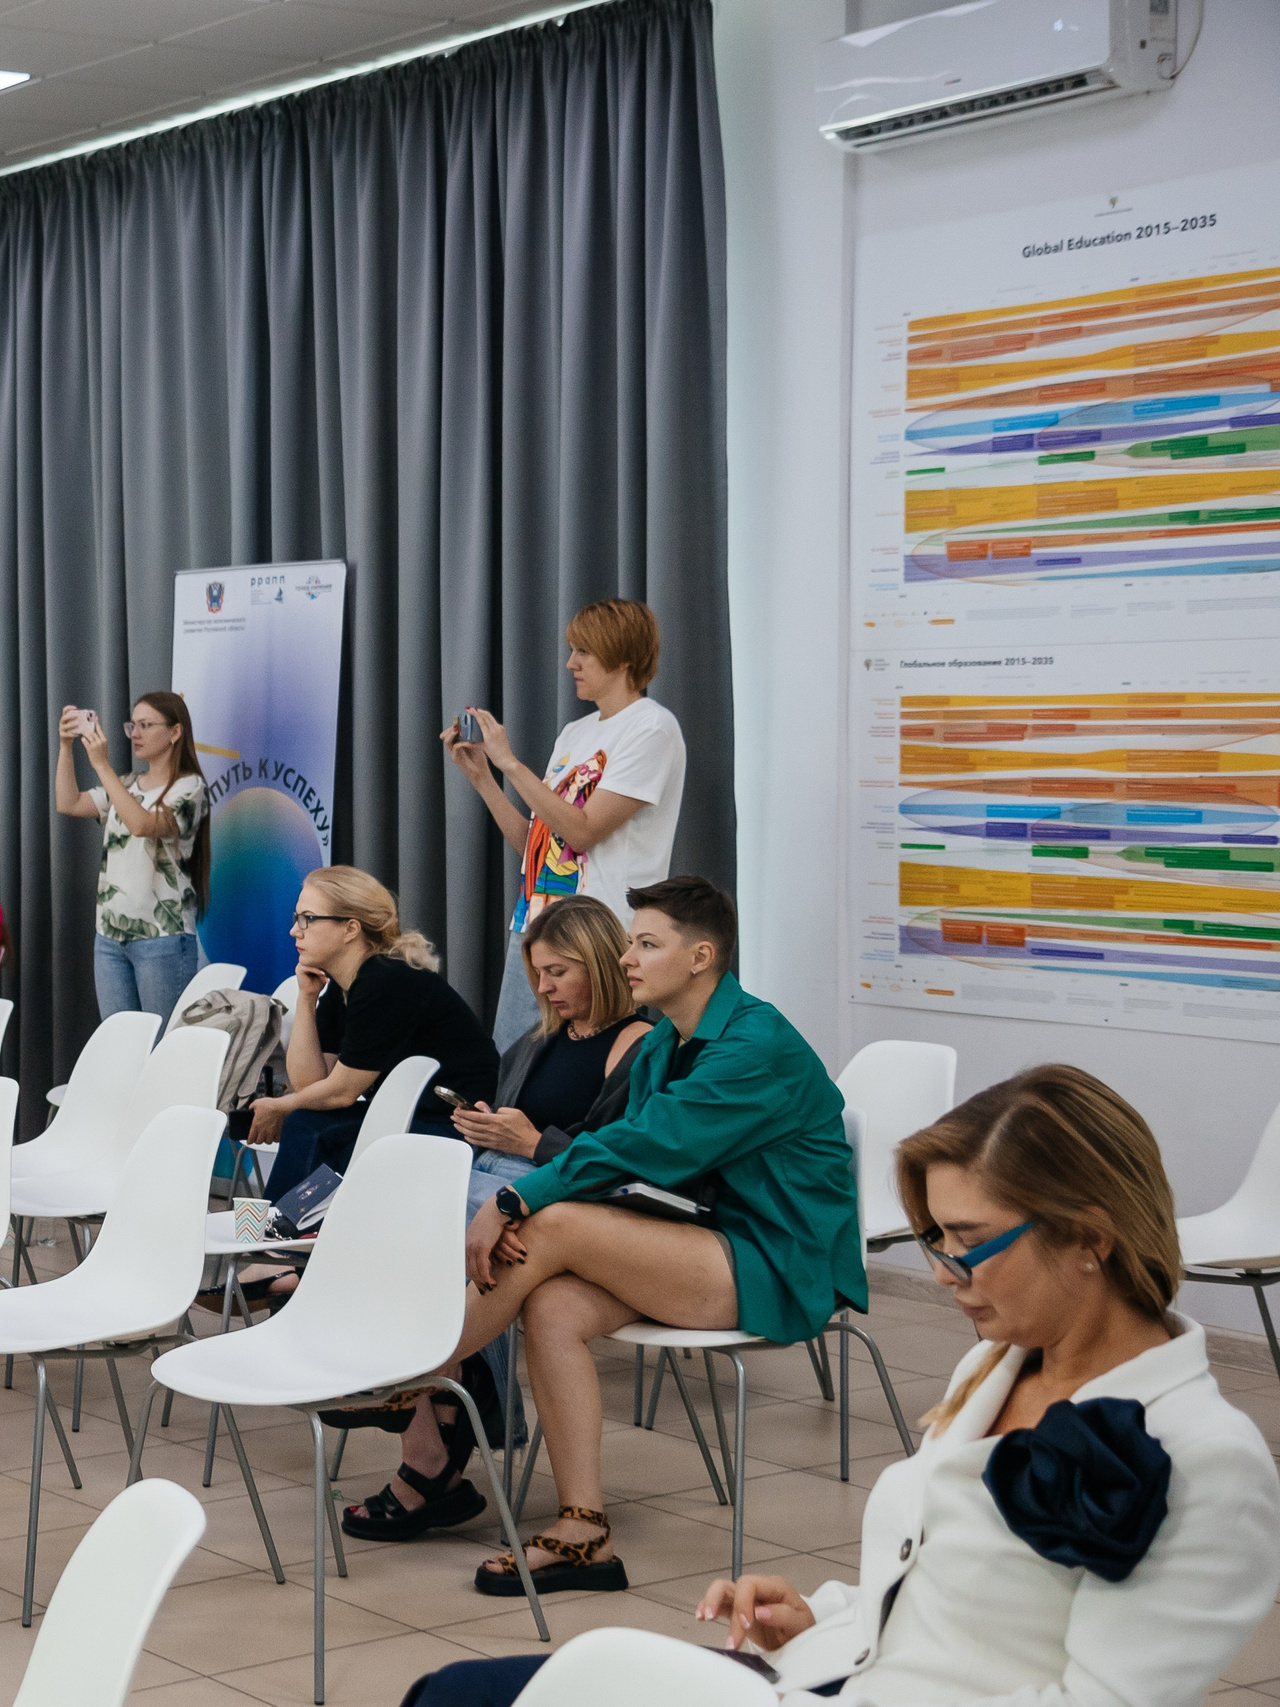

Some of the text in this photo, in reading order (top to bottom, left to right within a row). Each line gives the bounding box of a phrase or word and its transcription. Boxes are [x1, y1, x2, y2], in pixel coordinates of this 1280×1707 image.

[1022, 240, 1063, 258] Global
[1067, 231, 1132, 251] Education
[900, 659, 946, 669] Глобальное
[948, 658, 1002, 669] образование
[208, 758, 330, 847] ПУТЬ К УСПЕХУ»
